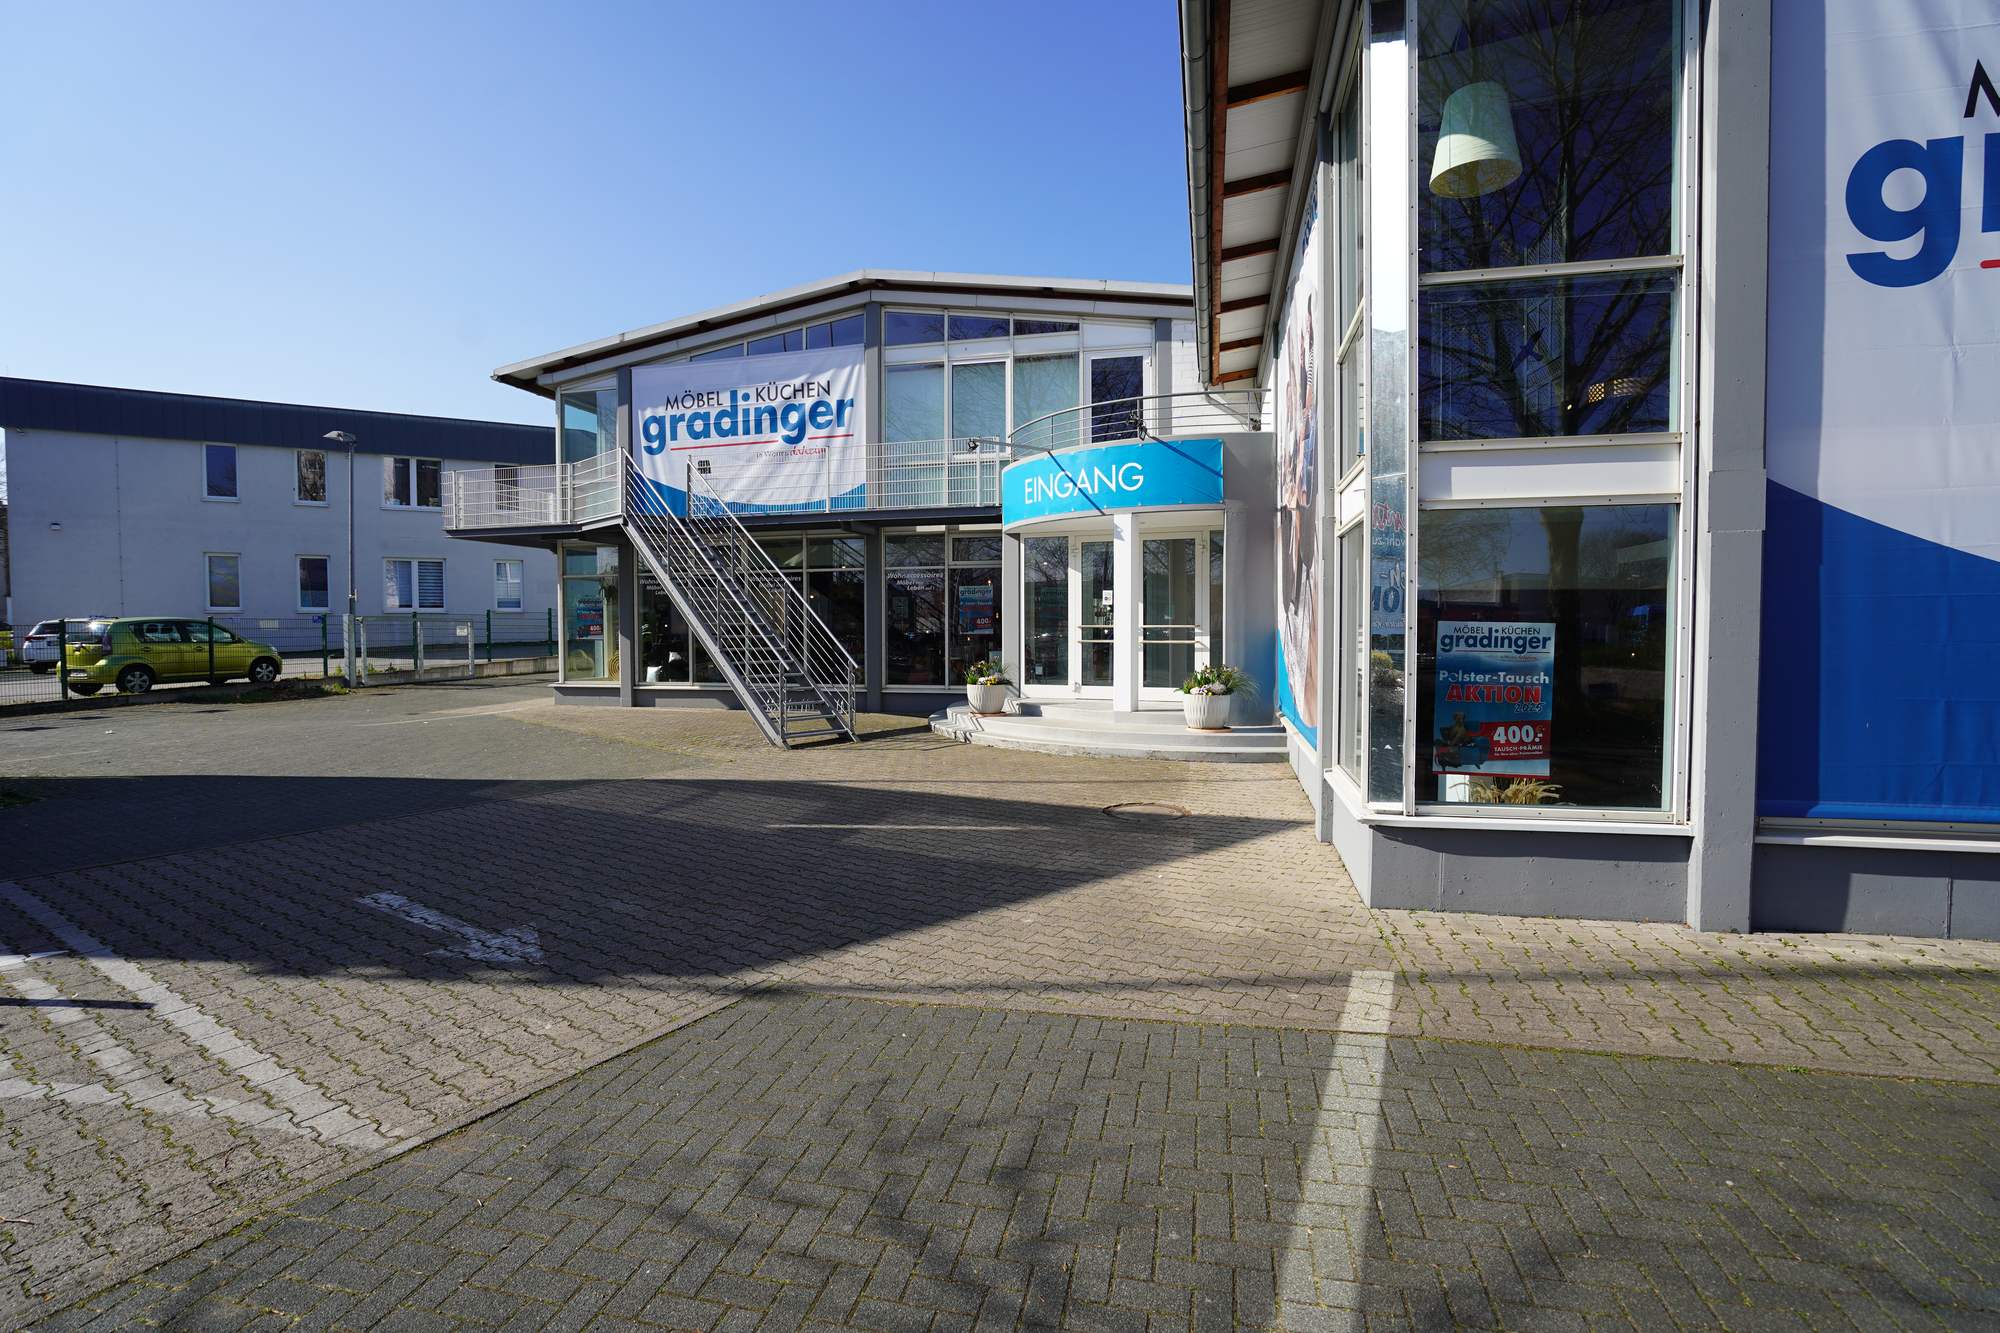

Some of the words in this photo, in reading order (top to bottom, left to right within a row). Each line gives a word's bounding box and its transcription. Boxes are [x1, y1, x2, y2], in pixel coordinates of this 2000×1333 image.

[665, 390, 724, 411] MÖBEL
[755, 380, 831, 403] KÜCHEN
[642, 390, 854, 455] gradinger
[1024, 462, 1145, 505] EINGANG
[1440, 627, 1552, 654] gradinger
[1453, 625, 1485, 635] MÖBEL
[1501, 626, 1541, 635] KÜCHEN
[1445, 684, 1543, 704] AKTION
